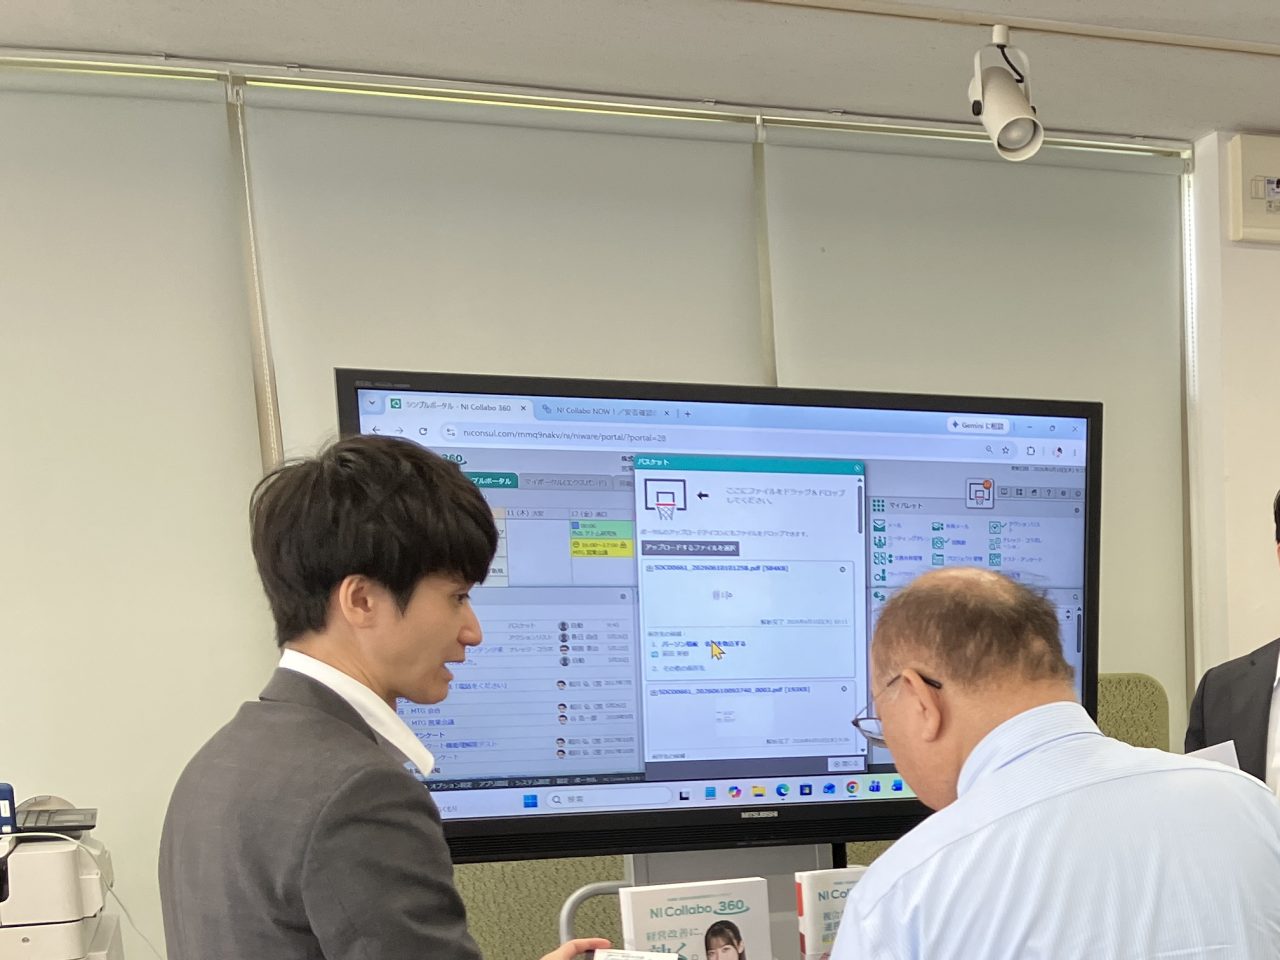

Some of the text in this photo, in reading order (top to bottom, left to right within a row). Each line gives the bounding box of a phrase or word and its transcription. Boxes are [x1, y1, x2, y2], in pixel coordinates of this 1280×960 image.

[470, 404, 496, 412] Collabo
[961, 422, 983, 430] Gemini
[637, 457, 669, 467] バスケット
[471, 477, 512, 485] プルポータル
[818, 890, 830, 901] NI
[649, 899, 745, 919] NI Collabo 360
